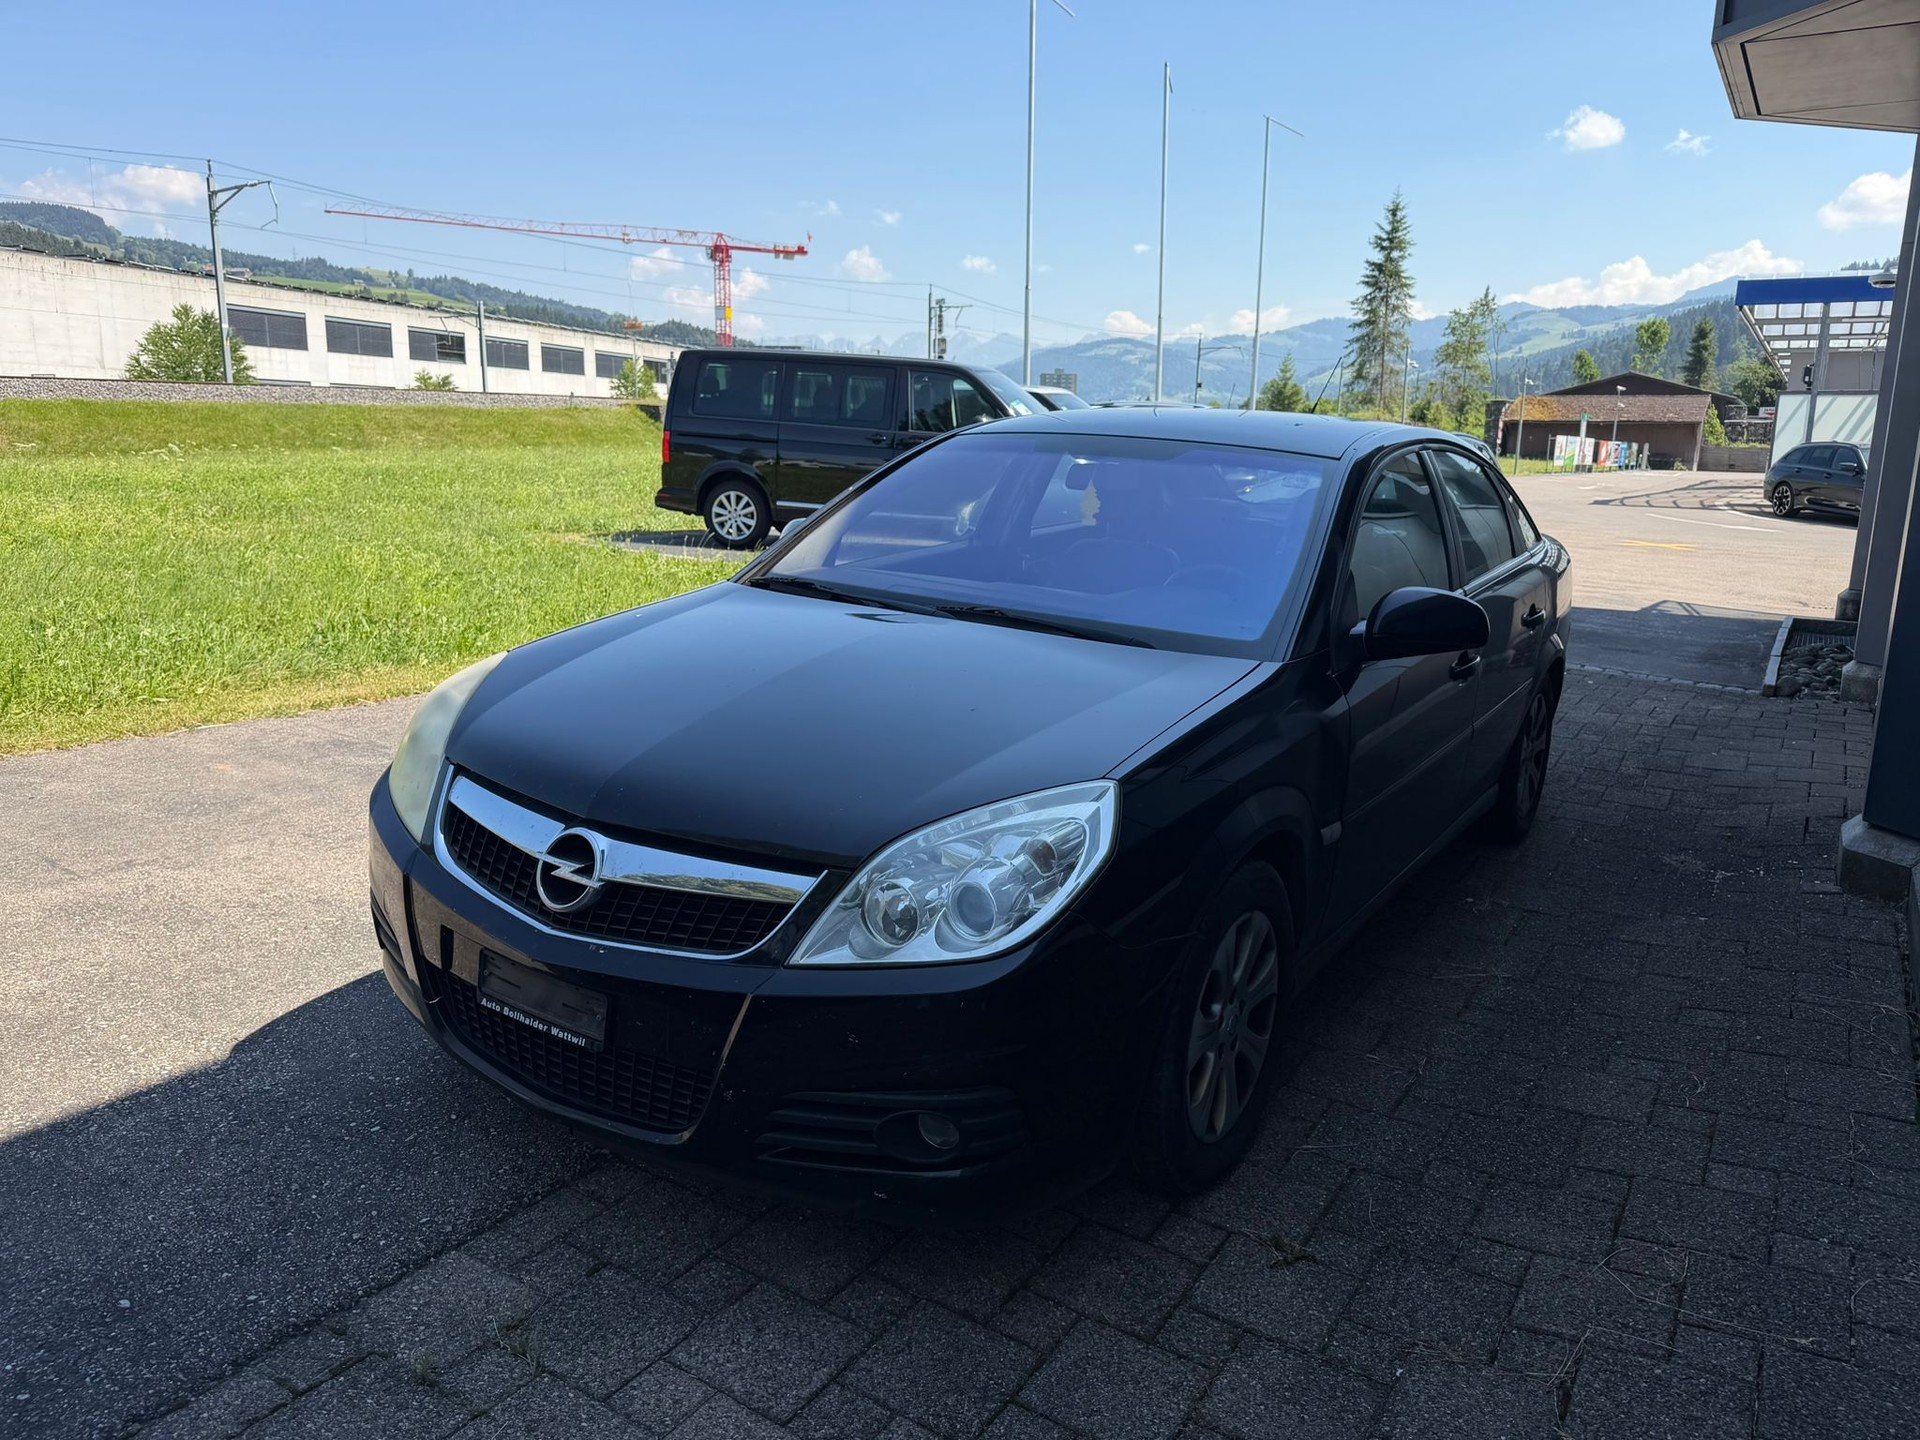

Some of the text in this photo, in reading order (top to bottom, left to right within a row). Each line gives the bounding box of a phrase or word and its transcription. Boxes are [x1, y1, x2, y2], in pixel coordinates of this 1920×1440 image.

[481, 998, 586, 1047] Auto Bollhalder Wattwil
